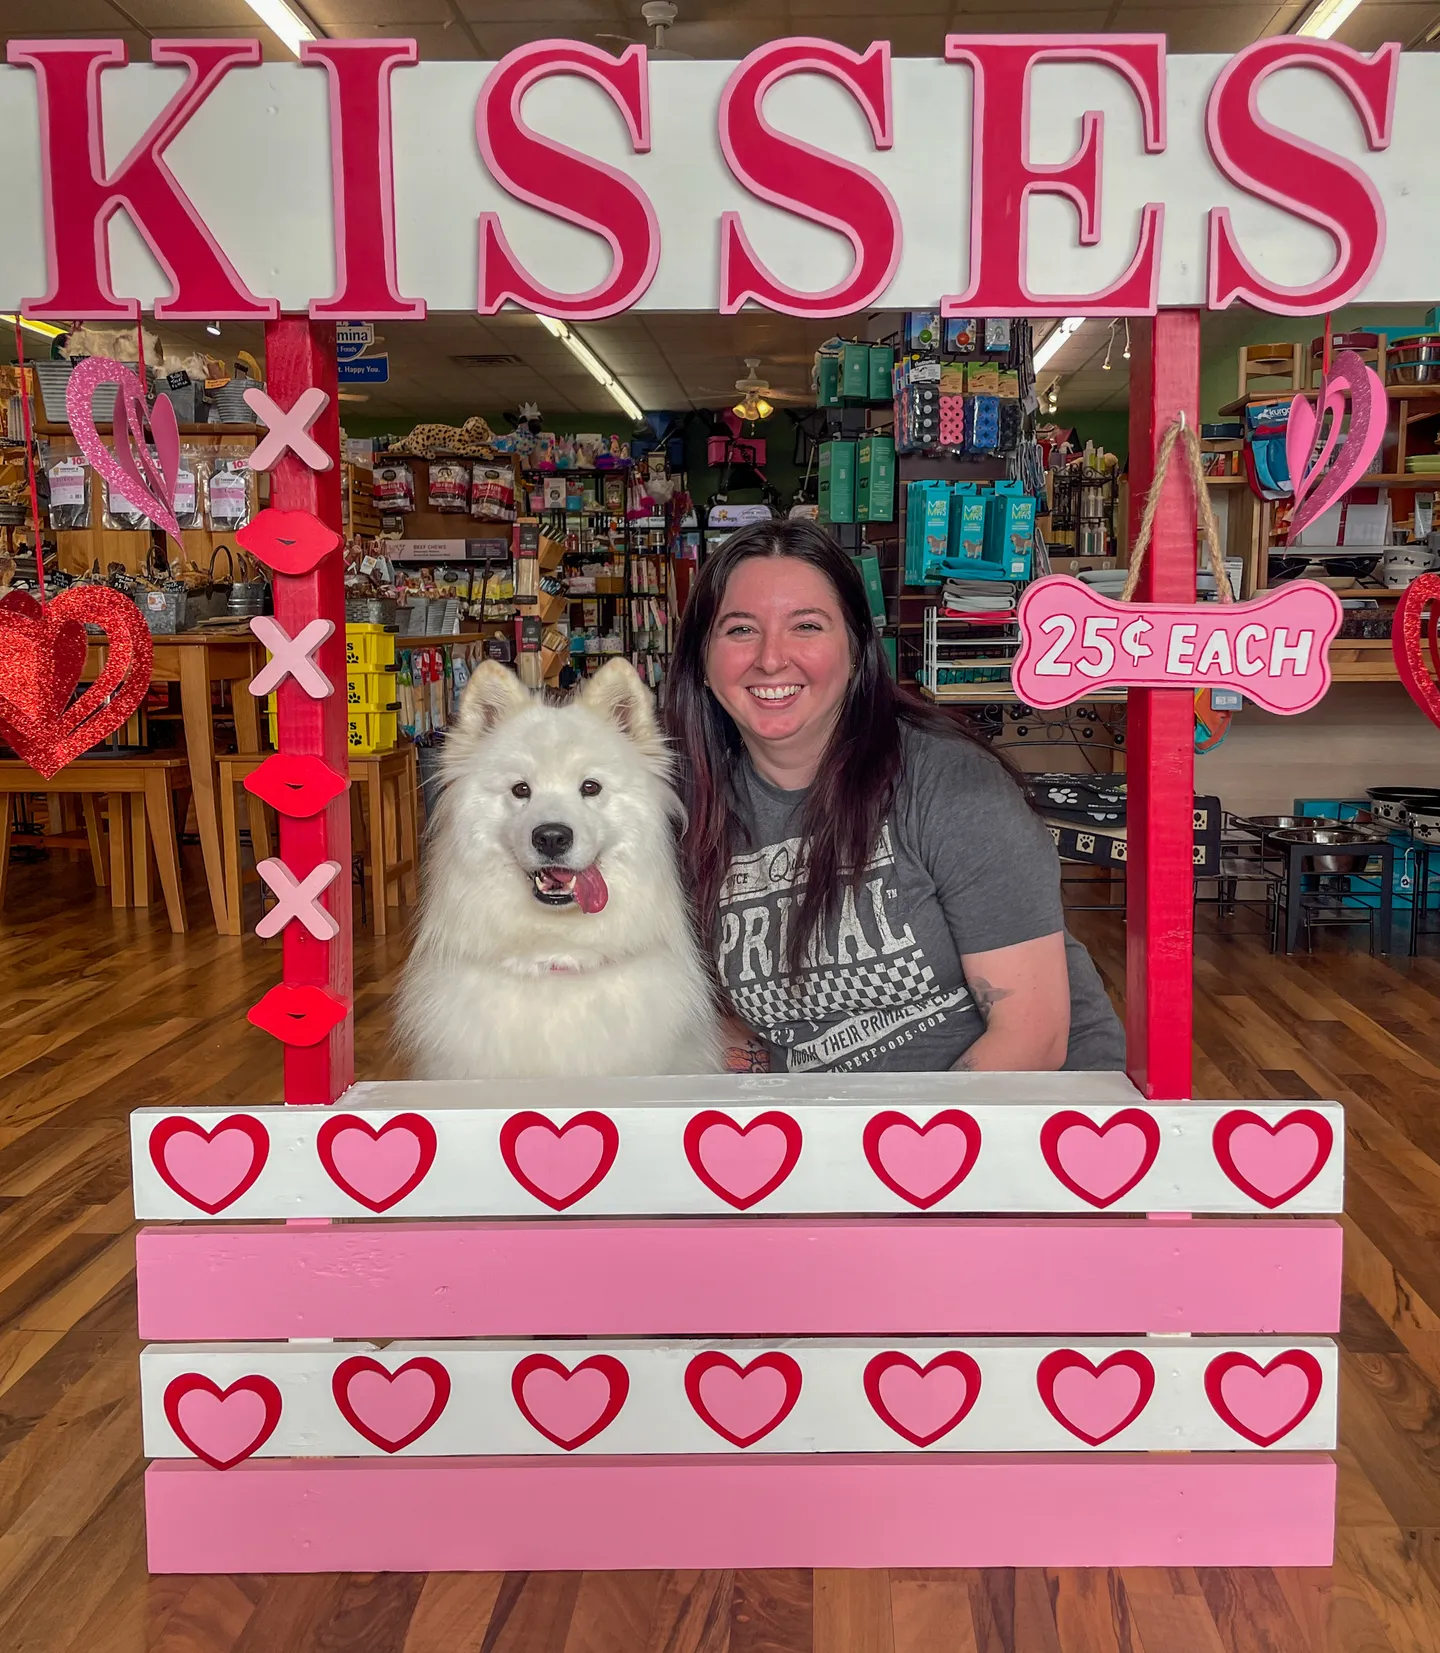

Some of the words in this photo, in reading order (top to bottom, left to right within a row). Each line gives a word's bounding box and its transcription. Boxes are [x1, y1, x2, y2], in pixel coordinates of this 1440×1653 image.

[6, 33, 1401, 321] KISSES
[337, 328, 368, 342] mina
[344, 365, 365, 375] Happy
[1034, 613, 1154, 678] 25¢
[1165, 622, 1315, 678] EACH
[821, 1022, 864, 1057] THEIR
